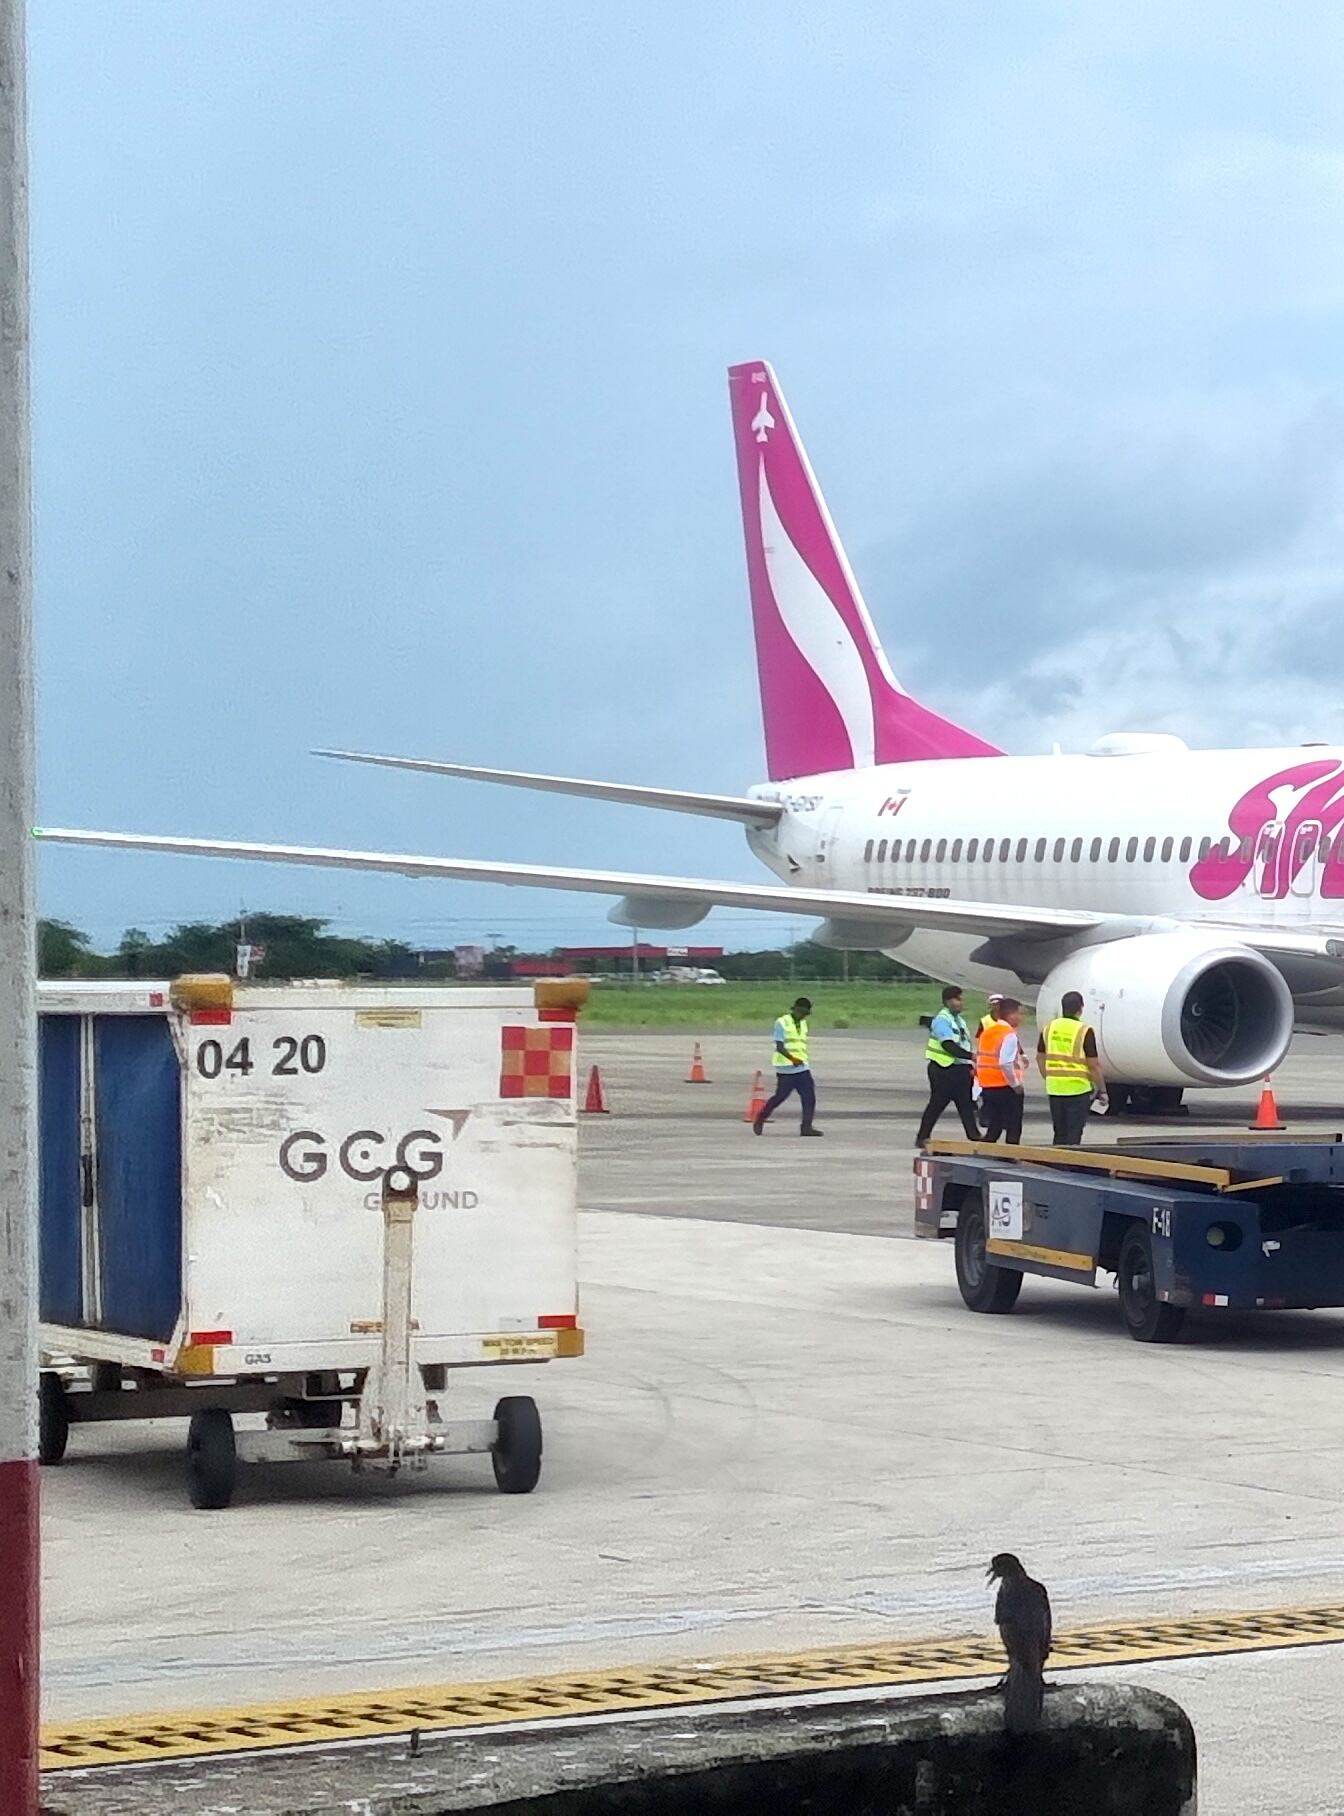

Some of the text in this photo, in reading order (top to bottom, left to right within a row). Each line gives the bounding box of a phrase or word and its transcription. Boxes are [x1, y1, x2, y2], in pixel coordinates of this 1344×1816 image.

[197, 1034, 326, 1079] 04 20
[279, 1130, 443, 1182] GCG
[363, 1190, 479, 1211] GUND
